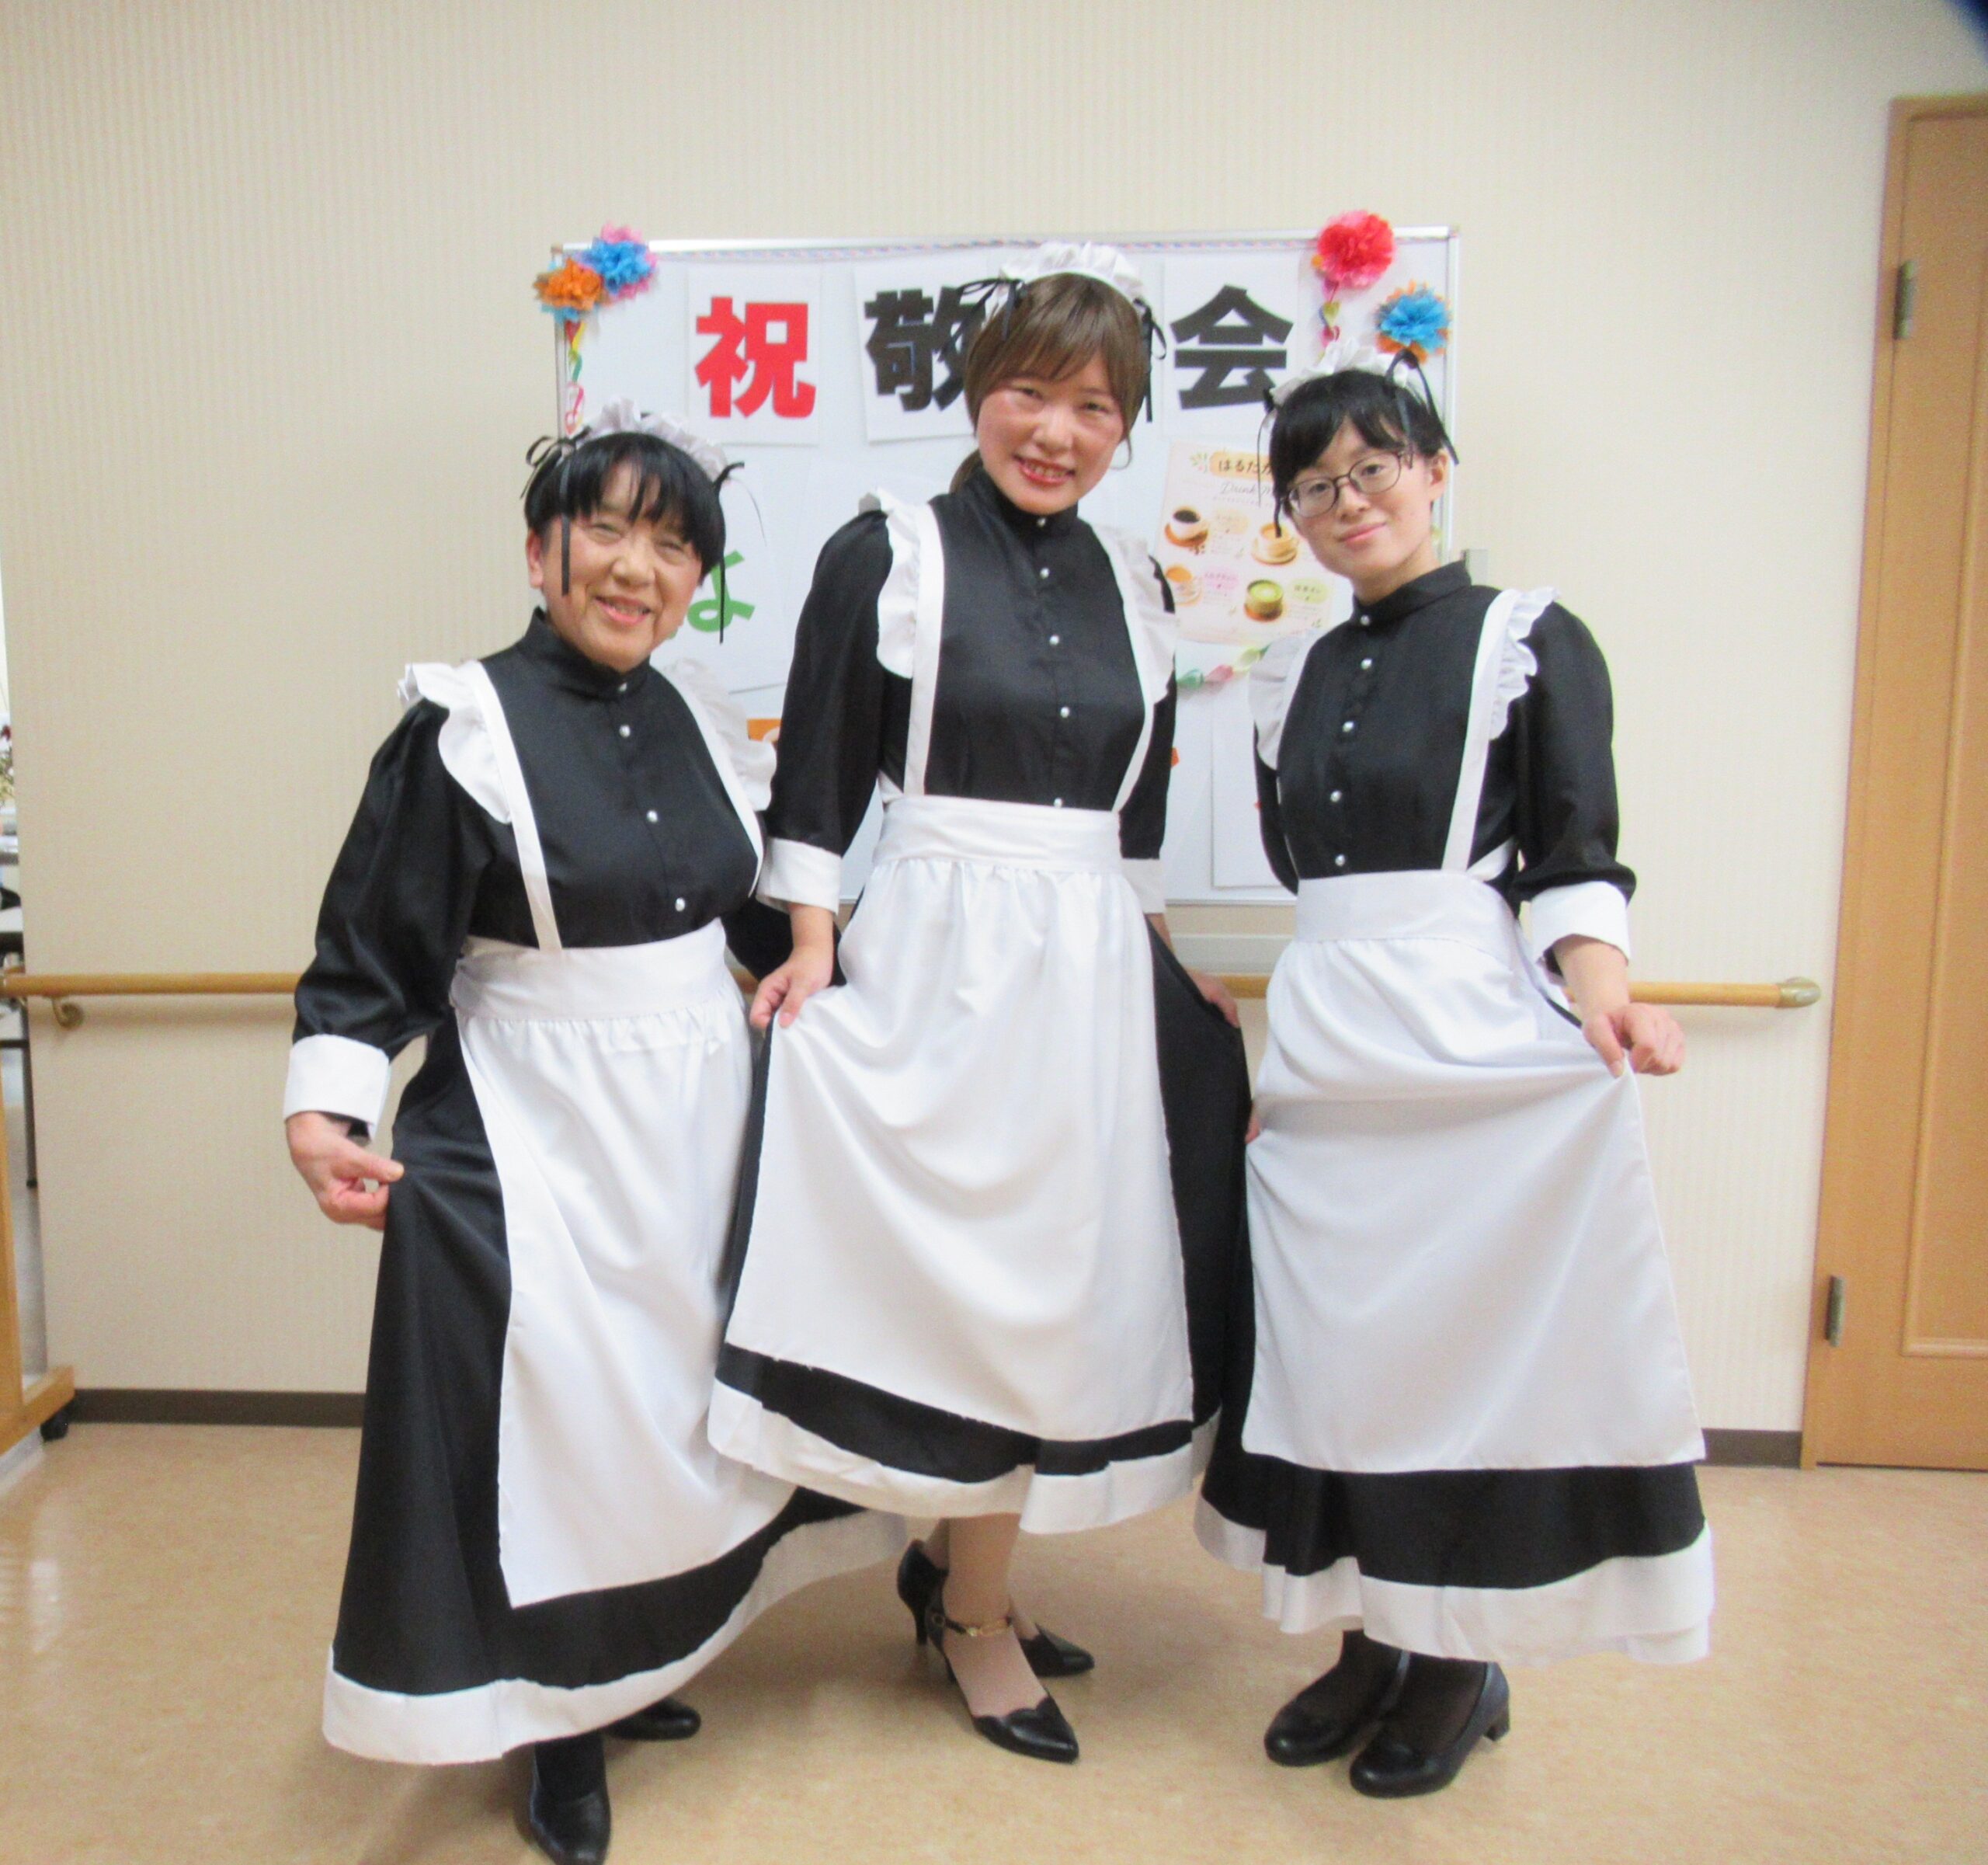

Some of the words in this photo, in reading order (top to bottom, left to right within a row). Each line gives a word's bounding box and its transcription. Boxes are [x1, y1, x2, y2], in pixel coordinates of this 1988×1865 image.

[694, 295, 817, 418] 祝
[864, 286, 986, 412] 敬
[1170, 284, 1295, 410] 会
